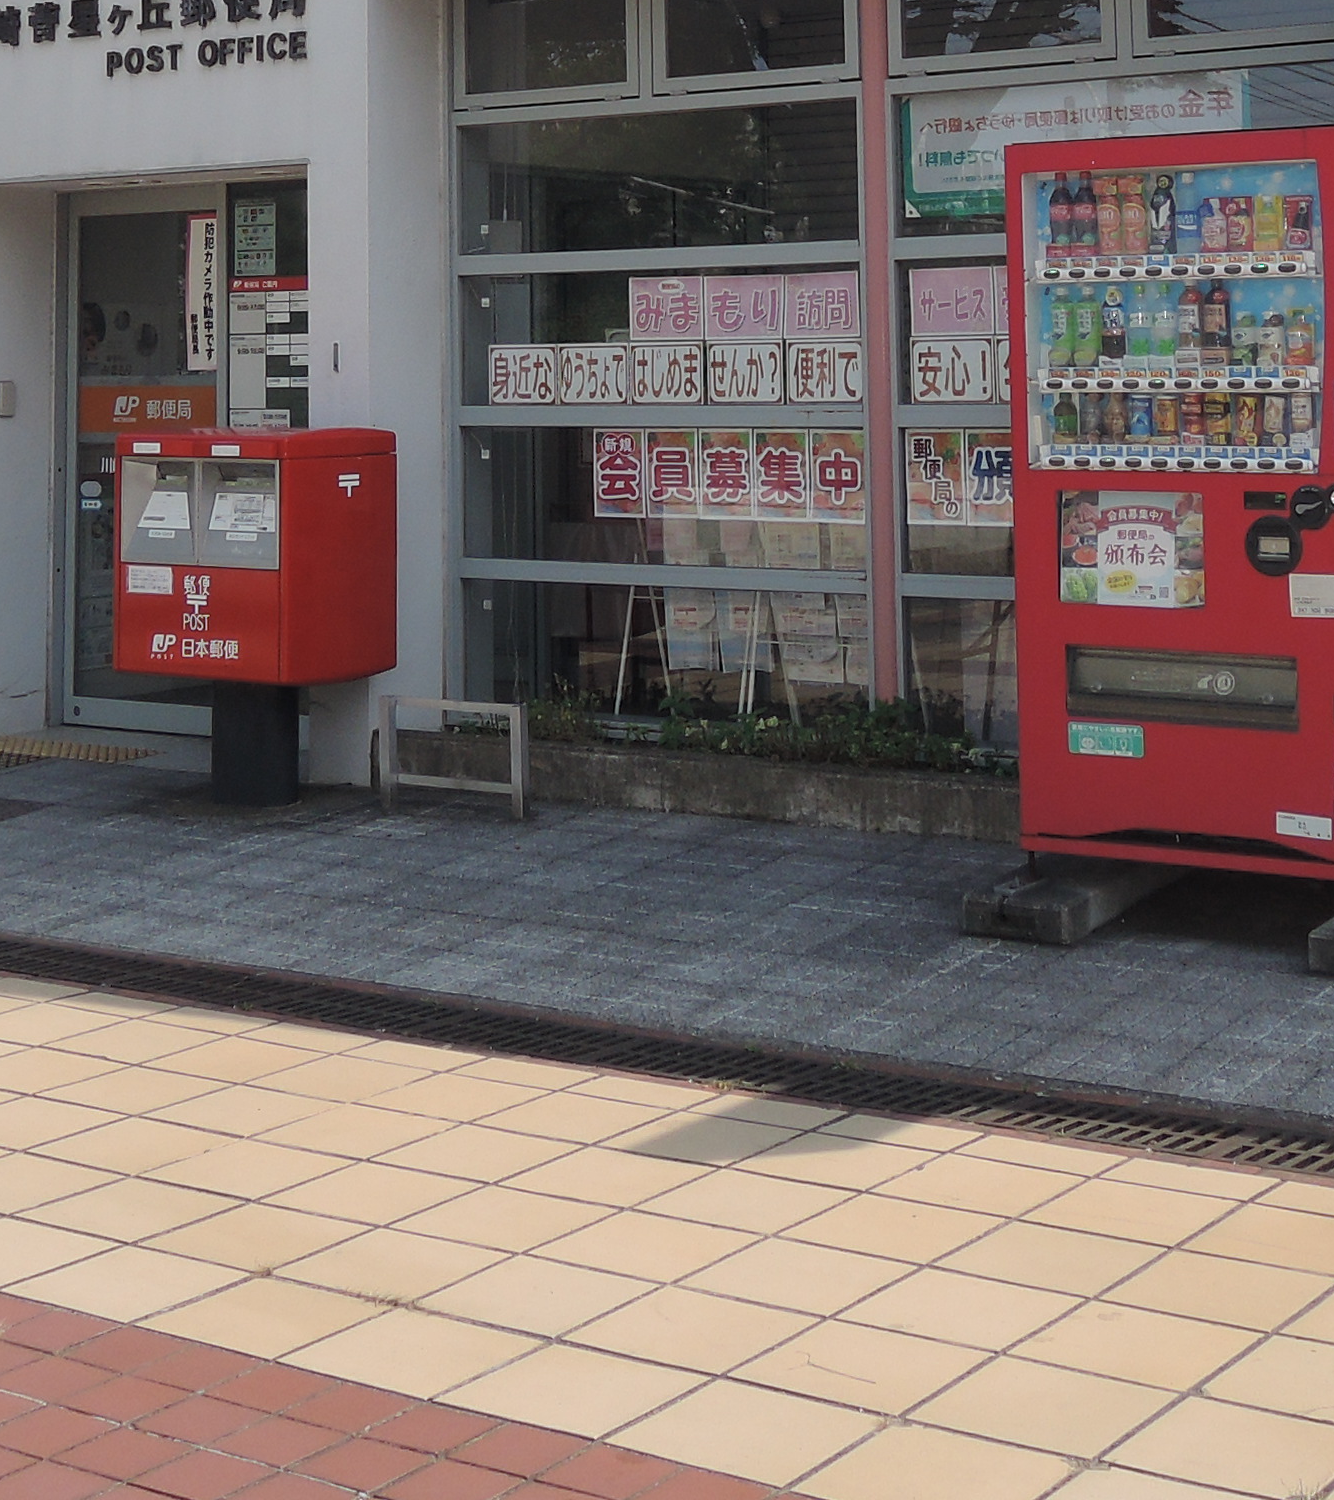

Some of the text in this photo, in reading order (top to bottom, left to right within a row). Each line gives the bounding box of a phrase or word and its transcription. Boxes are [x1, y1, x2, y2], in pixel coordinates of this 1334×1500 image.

[106, 31, 307, 77] POST OFFICE
[203, 222, 216, 361] 防犯カメラ作動中です
[920, 288, 987, 322] サービス
[146, 399, 192, 420] 郵便局
[603, 436, 634, 453] 新規
[597, 446, 862, 505] 会員募集中
[1104, 544, 1168, 566] 頒布会
[183, 574, 210, 596] 郵便
[182, 613, 210, 631] POST
[181, 638, 239, 659] 日本郵便
